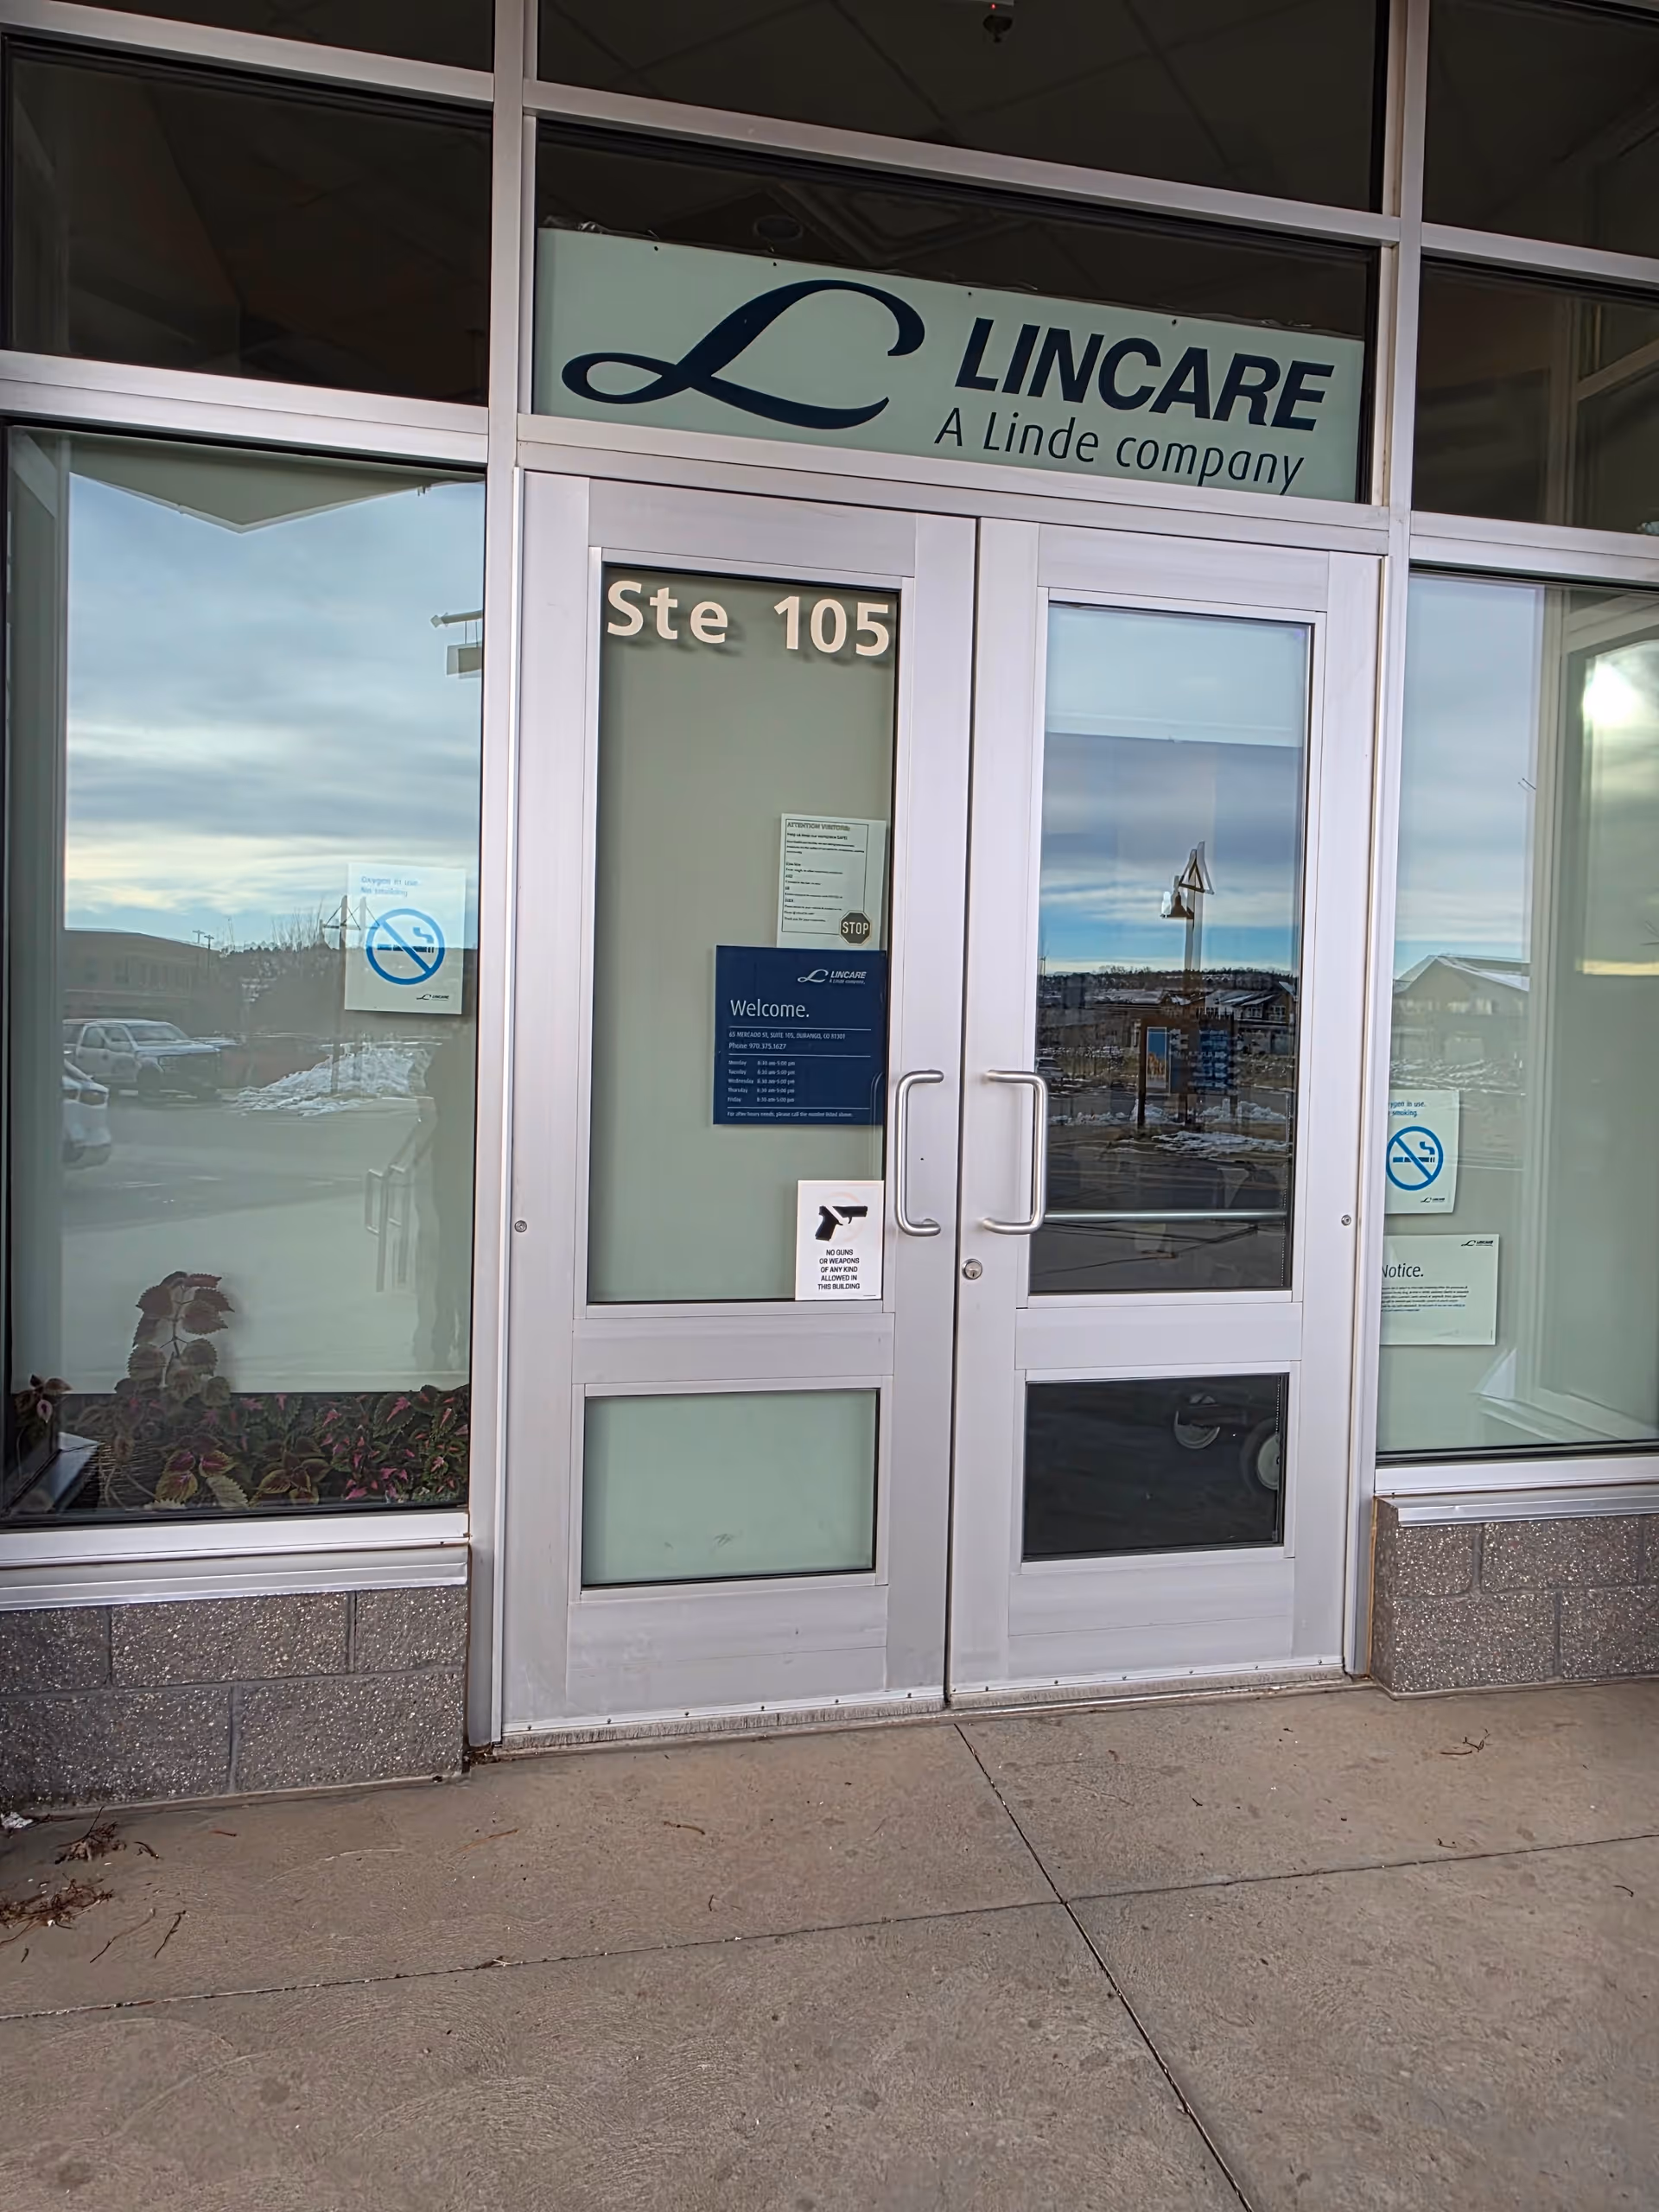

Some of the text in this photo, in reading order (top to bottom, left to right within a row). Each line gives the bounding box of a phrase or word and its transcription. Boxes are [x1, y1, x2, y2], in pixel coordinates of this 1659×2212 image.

[955, 317, 1335, 431] LINCARE
[934, 408, 1305, 496] A Linde company
[607, 581, 891, 657] Ste 105
[360, 875, 391, 887] Oxygen
[393, 877, 402, 886] in
[842, 921, 869, 935] STOP
[830, 970, 867, 979] LINCARE
[730, 999, 810, 1018] Welcome.
